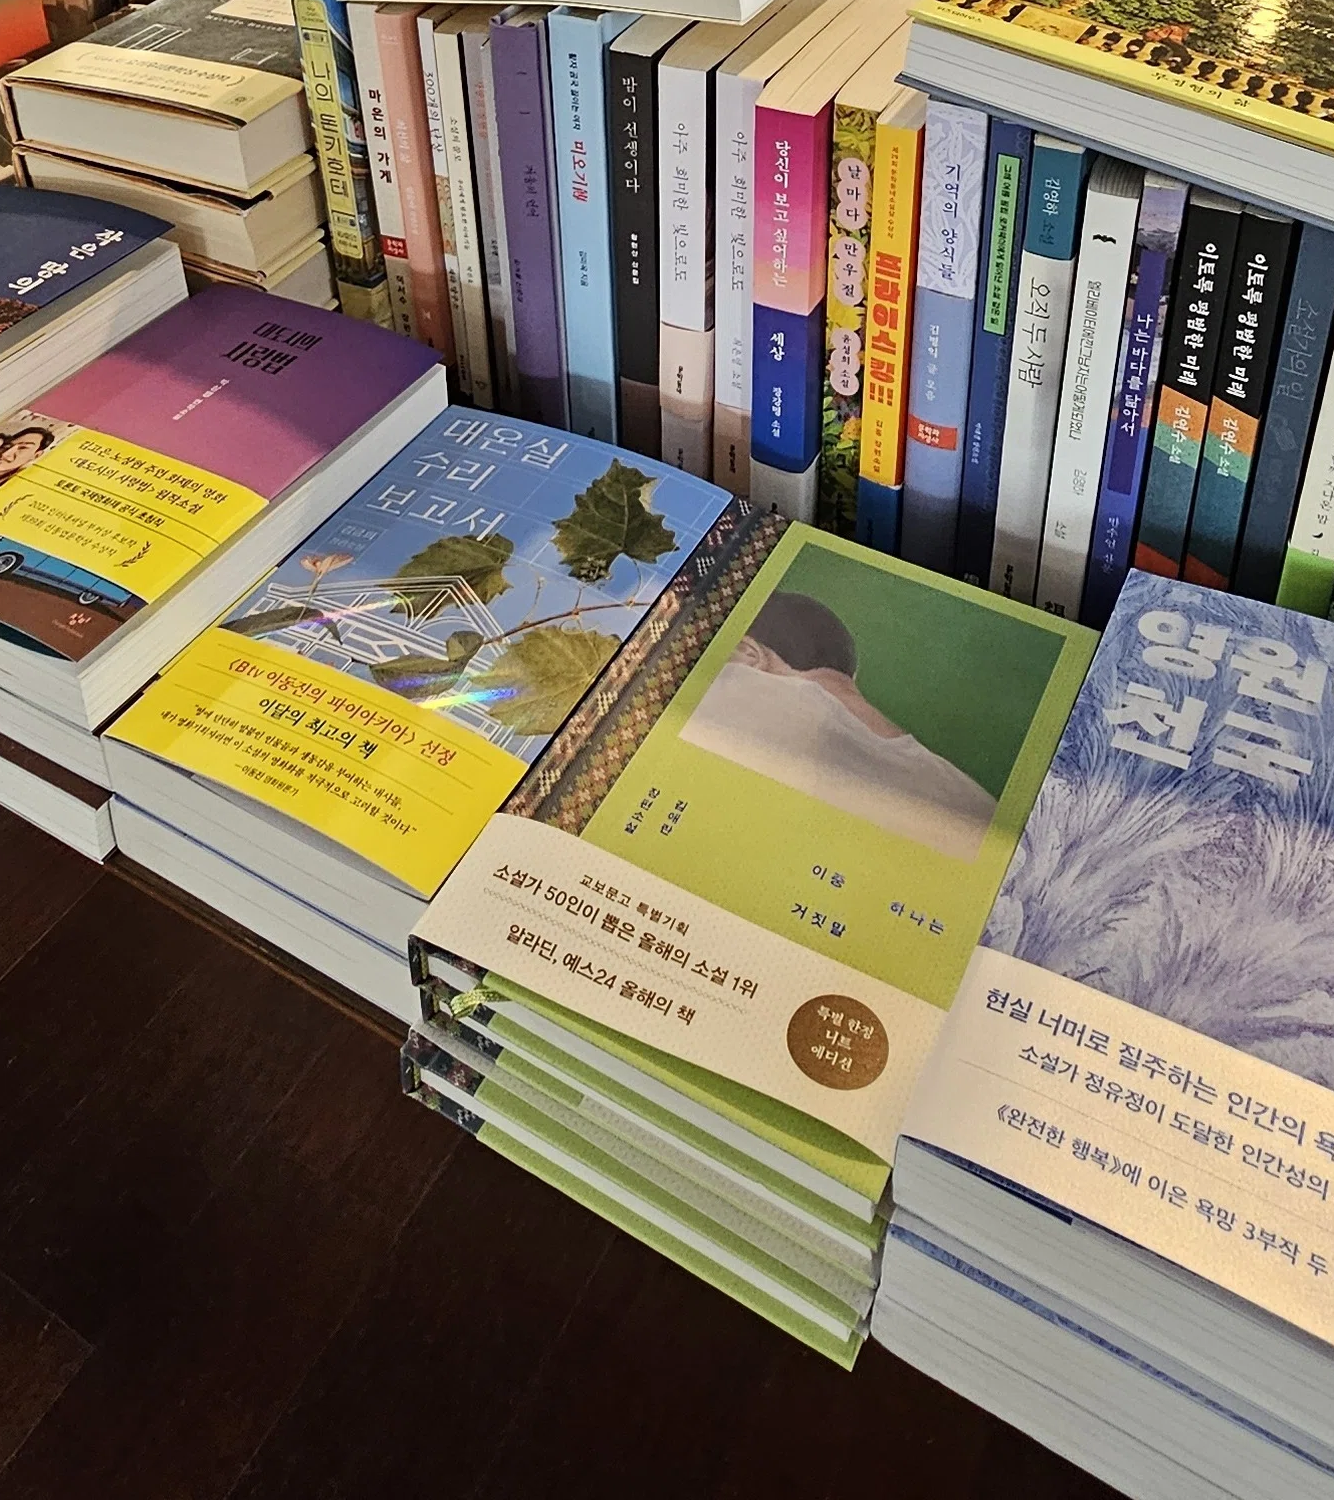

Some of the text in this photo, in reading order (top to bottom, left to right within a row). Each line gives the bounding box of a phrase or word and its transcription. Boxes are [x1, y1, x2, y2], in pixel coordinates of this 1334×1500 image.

[310, 61, 349, 199] 나의 돈키호테
[368, 89, 394, 184] 마은의 가게
[622, 77, 640, 194] 밤이 선생이다
[672, 123, 690, 282] 아주 희미한 빛으로도
[772, 141, 791, 288] 당신이 보고 싶어하는
[938, 164, 961, 280] 기억의 양식들
[1042, 177, 1061, 216] 김영하
[69, 229, 124, 261] 작은
[842, 165, 862, 297] 날마다 만우절
[8, 260, 69, 295] 땅의
[252, 322, 323, 352] 대도시의
[770, 332, 785, 361] 세상
[1018, 277, 1051, 389] 오직 두 사람
[1177, 243, 1219, 387] 이토록 평범한 미래
[1120, 313, 1153, 436] 나는 바다를 닮아서
[413, 451, 496, 491] 수리
[443, 418, 569, 469] 대온실
[366, 484, 505, 542] 보고서
[258, 697, 380, 761] 이달의 최고의 책
[266, 669, 329, 704] 이동진의
[420, 738, 458, 768] 선정
[1102, 681, 1313, 800] 천국
[624, 786, 661, 834] 장편소설
[660, 799, 688, 836] 김애란
[579, 873, 631, 908] 교보문고
[812, 864, 847, 889] 이중
[493, 863, 760, 1000] 소설가 50인이 뽑은 올해의 소설 1위
[790, 902, 848, 940] 거짓말
[889, 900, 946, 936] 하나는
[506, 922, 697, 1028] 알라딘, 예스24 올해의 책
[816, 1004, 876, 1041] 특별 한정
[825, 1029, 854, 1051] 니트
[810, 1043, 855, 1074] 에디션
[984, 986, 1035, 1027] 현실
[1036, 1006, 1111, 1054] 너머로
[1118, 1040, 1219, 1106] 질주하는
[1225, 1090, 1307, 1147] 인간의
[1017, 1043, 1080, 1085] 소설가
[1082, 1069, 1166, 1123] 정유정이
[1167, 1110, 1237, 1158] 도달한
[1239, 1138, 1330, 1199] 인간성의
[1146, 1172, 1190, 1211] 이은
[1193, 1195, 1238, 1235] 욕망
[1240, 1221, 1303, 1265] 3부작
[1304, 1245, 1332, 1279] 두
